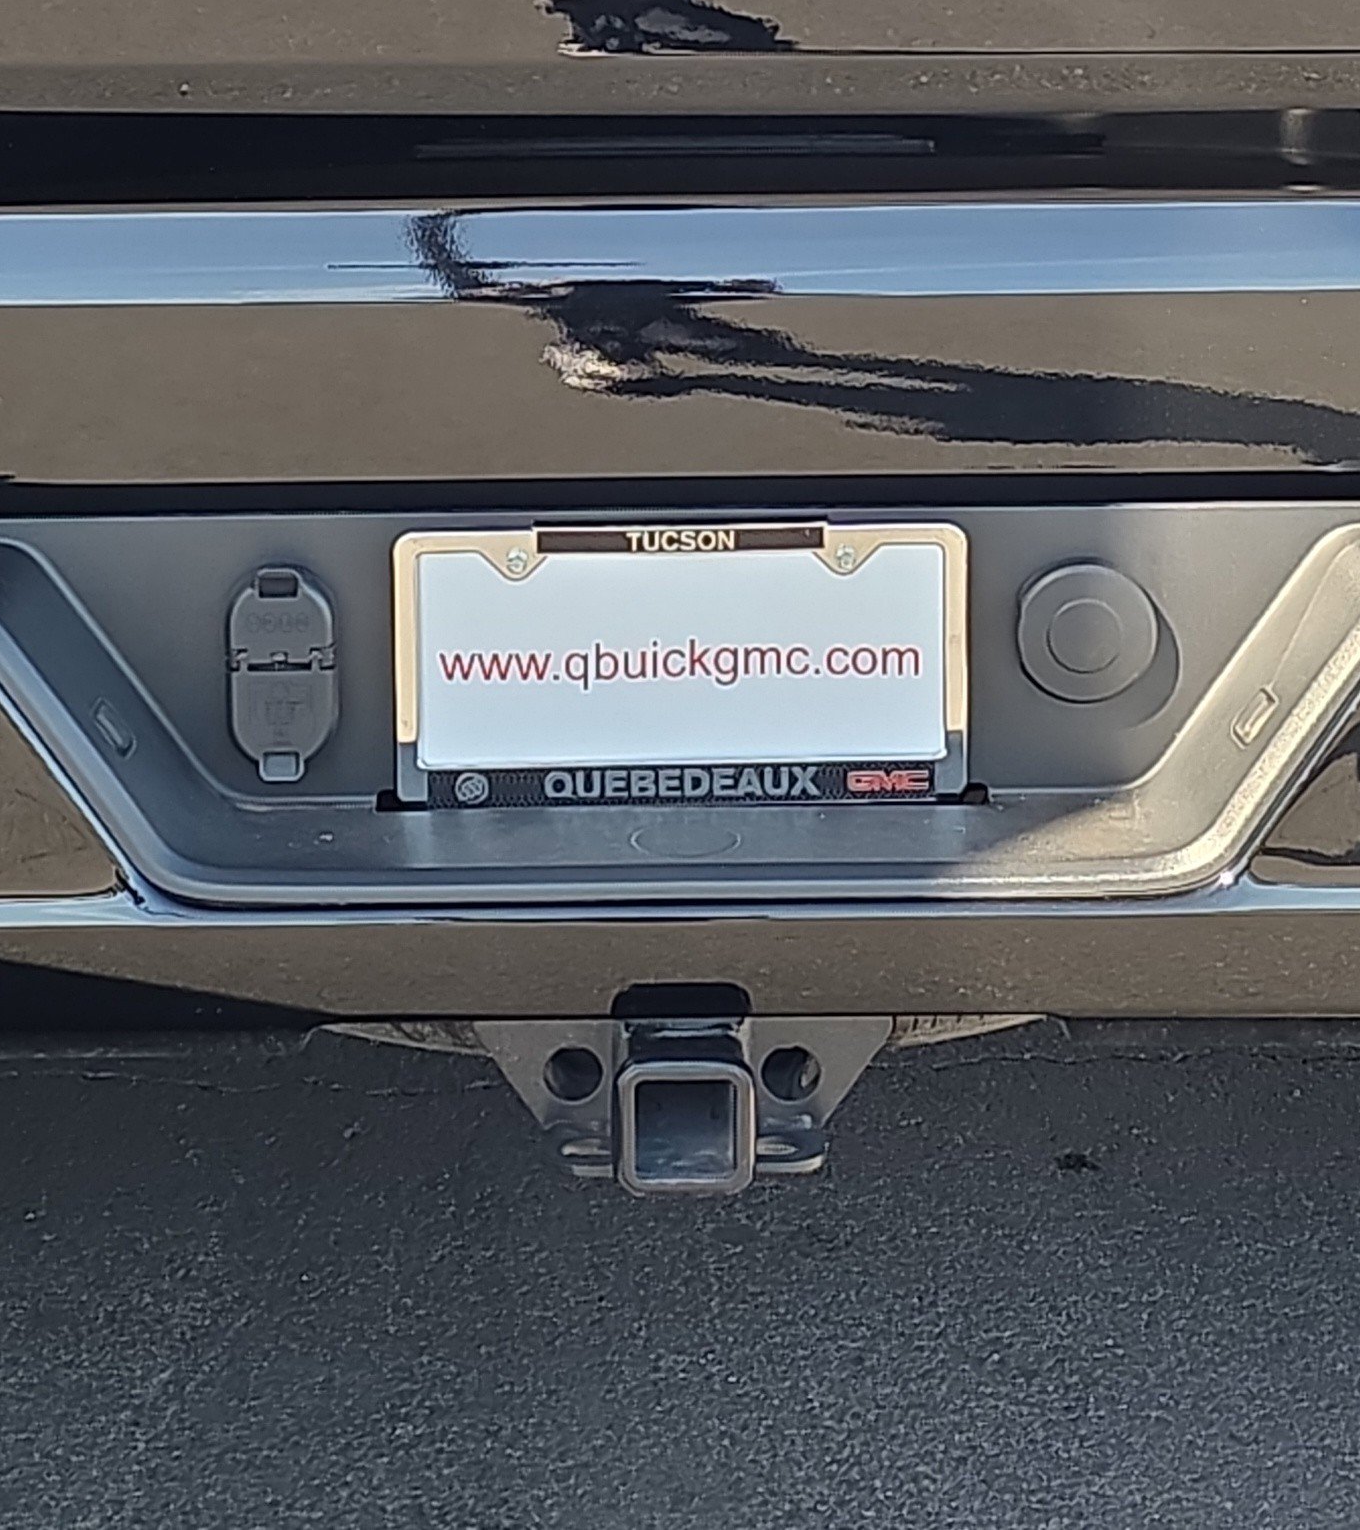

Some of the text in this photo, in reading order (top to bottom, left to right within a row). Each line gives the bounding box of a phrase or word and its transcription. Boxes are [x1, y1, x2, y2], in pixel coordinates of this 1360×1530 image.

[626, 530, 736, 552] TUCSON
[439, 640, 920, 689] www.qbuickgmc.com
[543, 767, 930, 800] QUEBEDEAUX GMC
